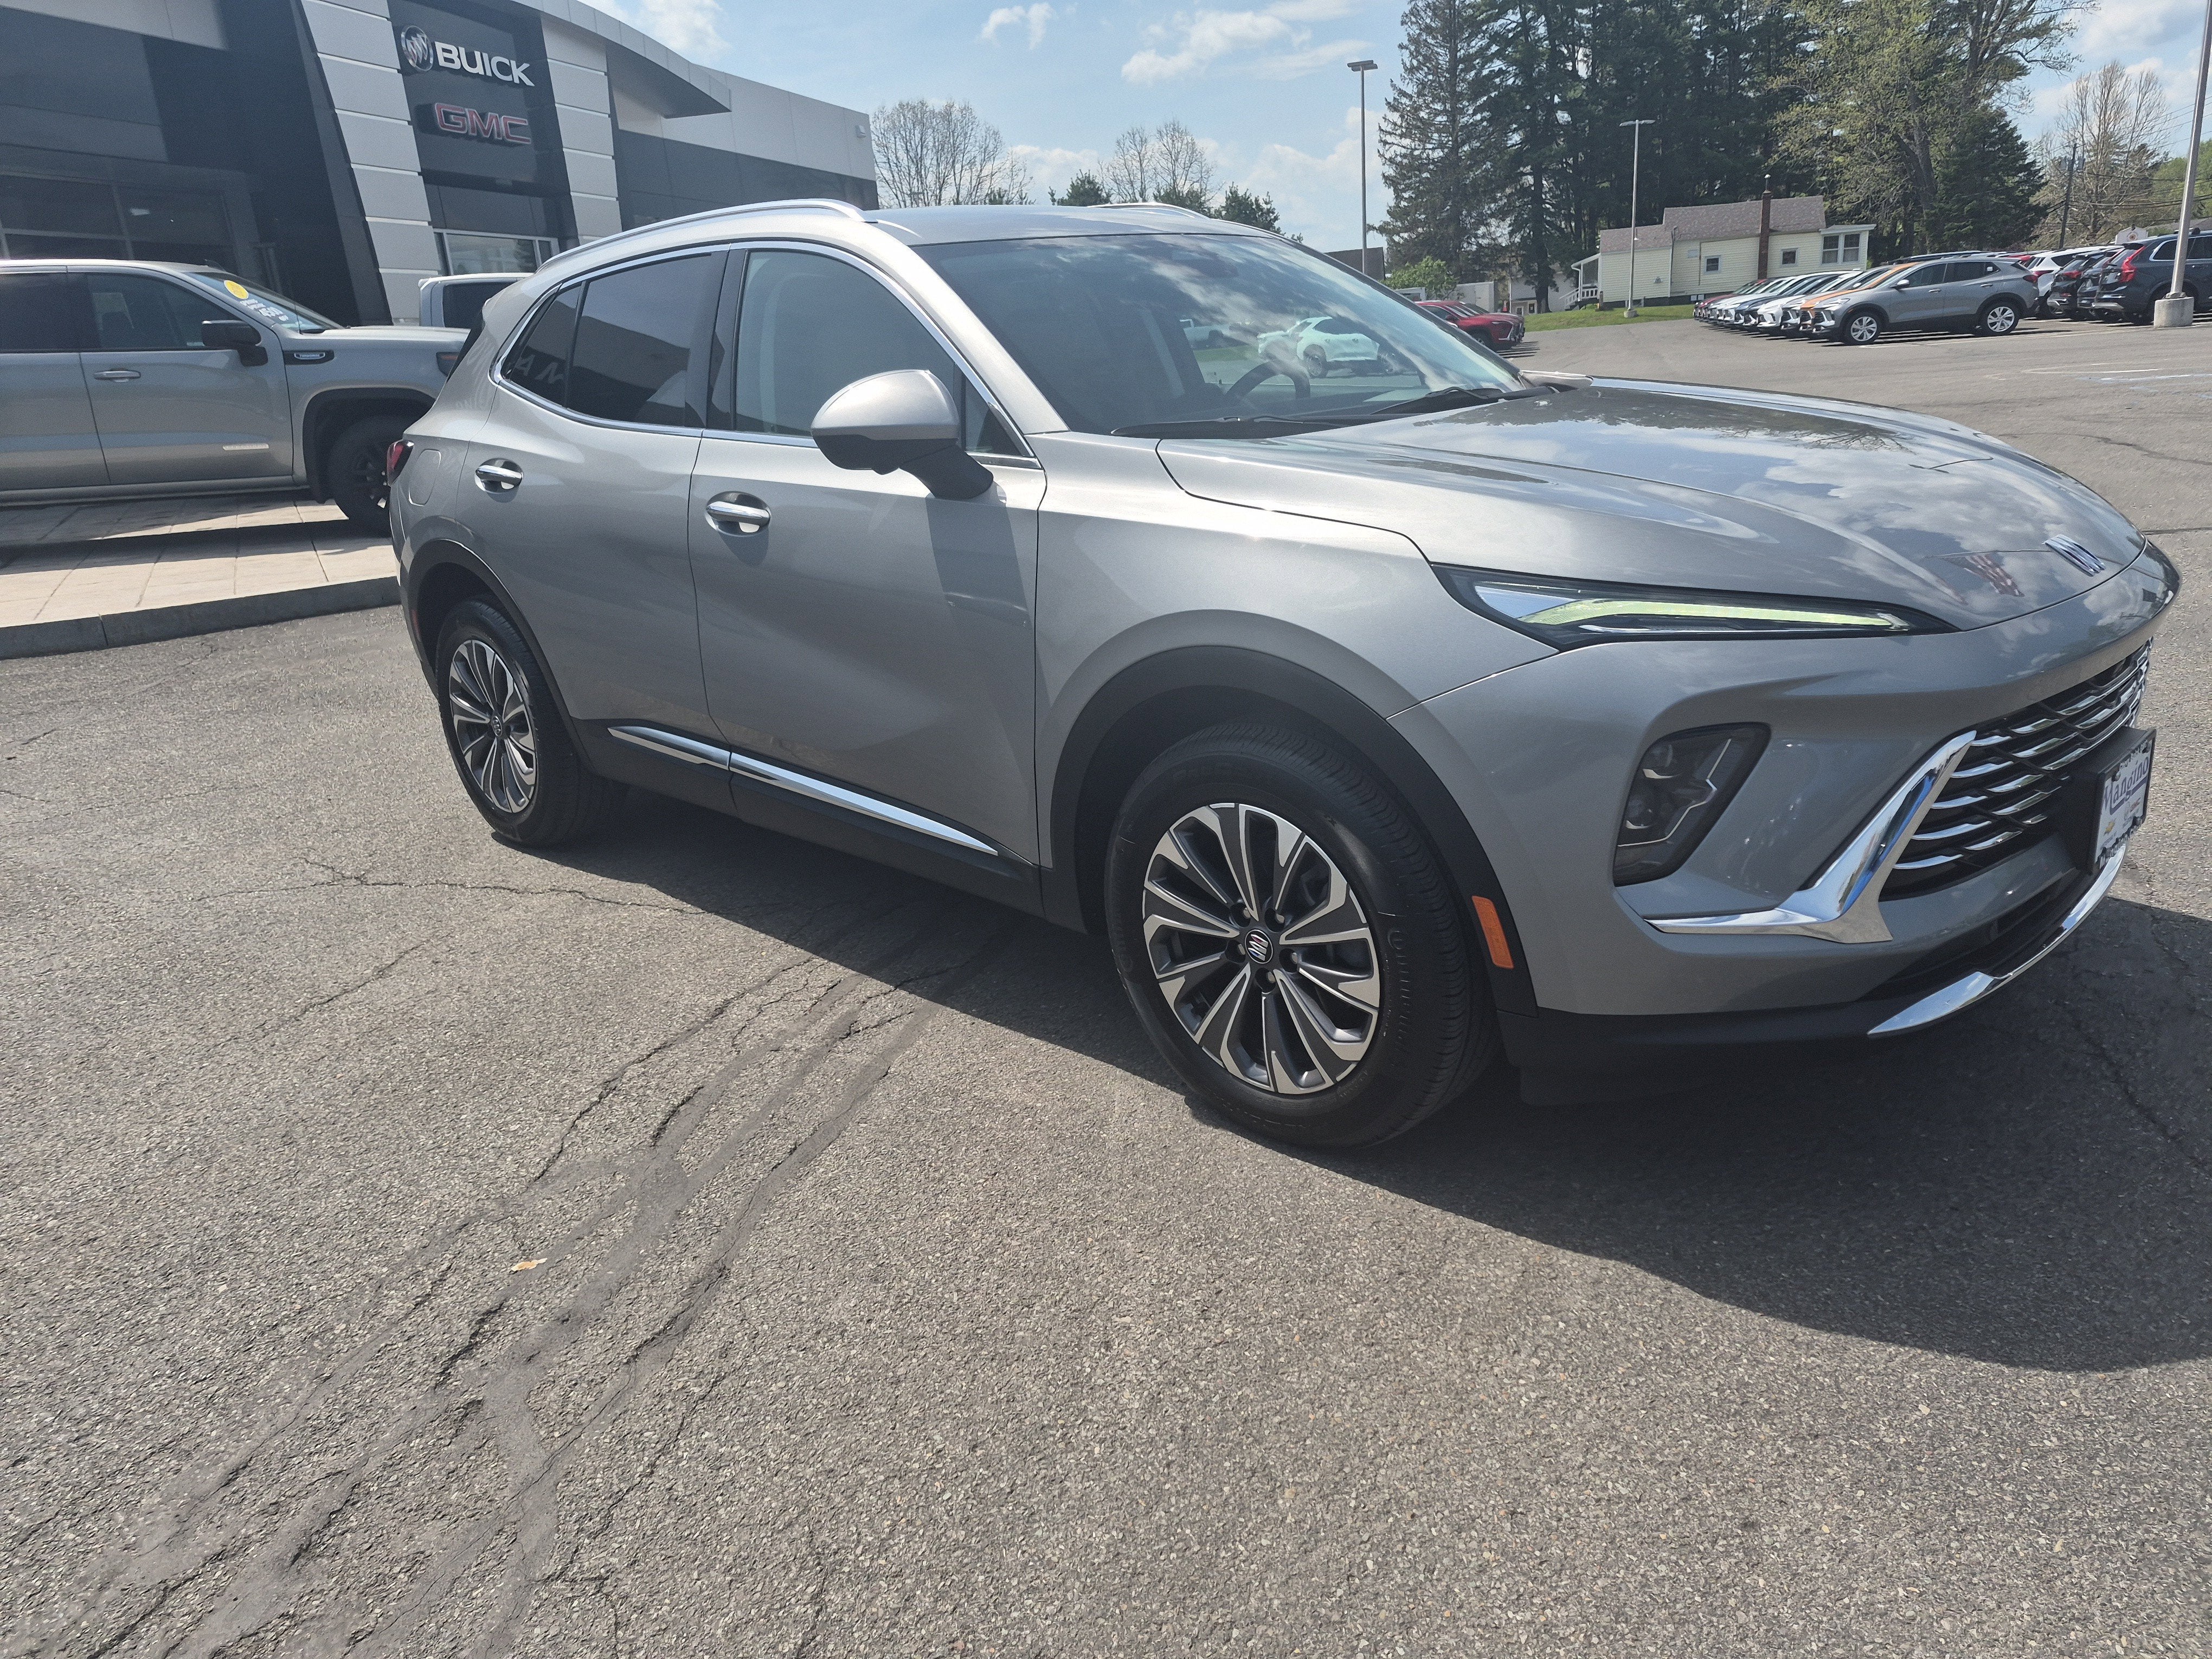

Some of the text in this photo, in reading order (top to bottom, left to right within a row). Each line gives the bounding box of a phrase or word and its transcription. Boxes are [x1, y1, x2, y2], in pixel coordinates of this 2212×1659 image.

[435, 41, 535, 87] BUICK
[435, 102, 532, 144] GMC
[2103, 756, 2149, 815] Mangino
